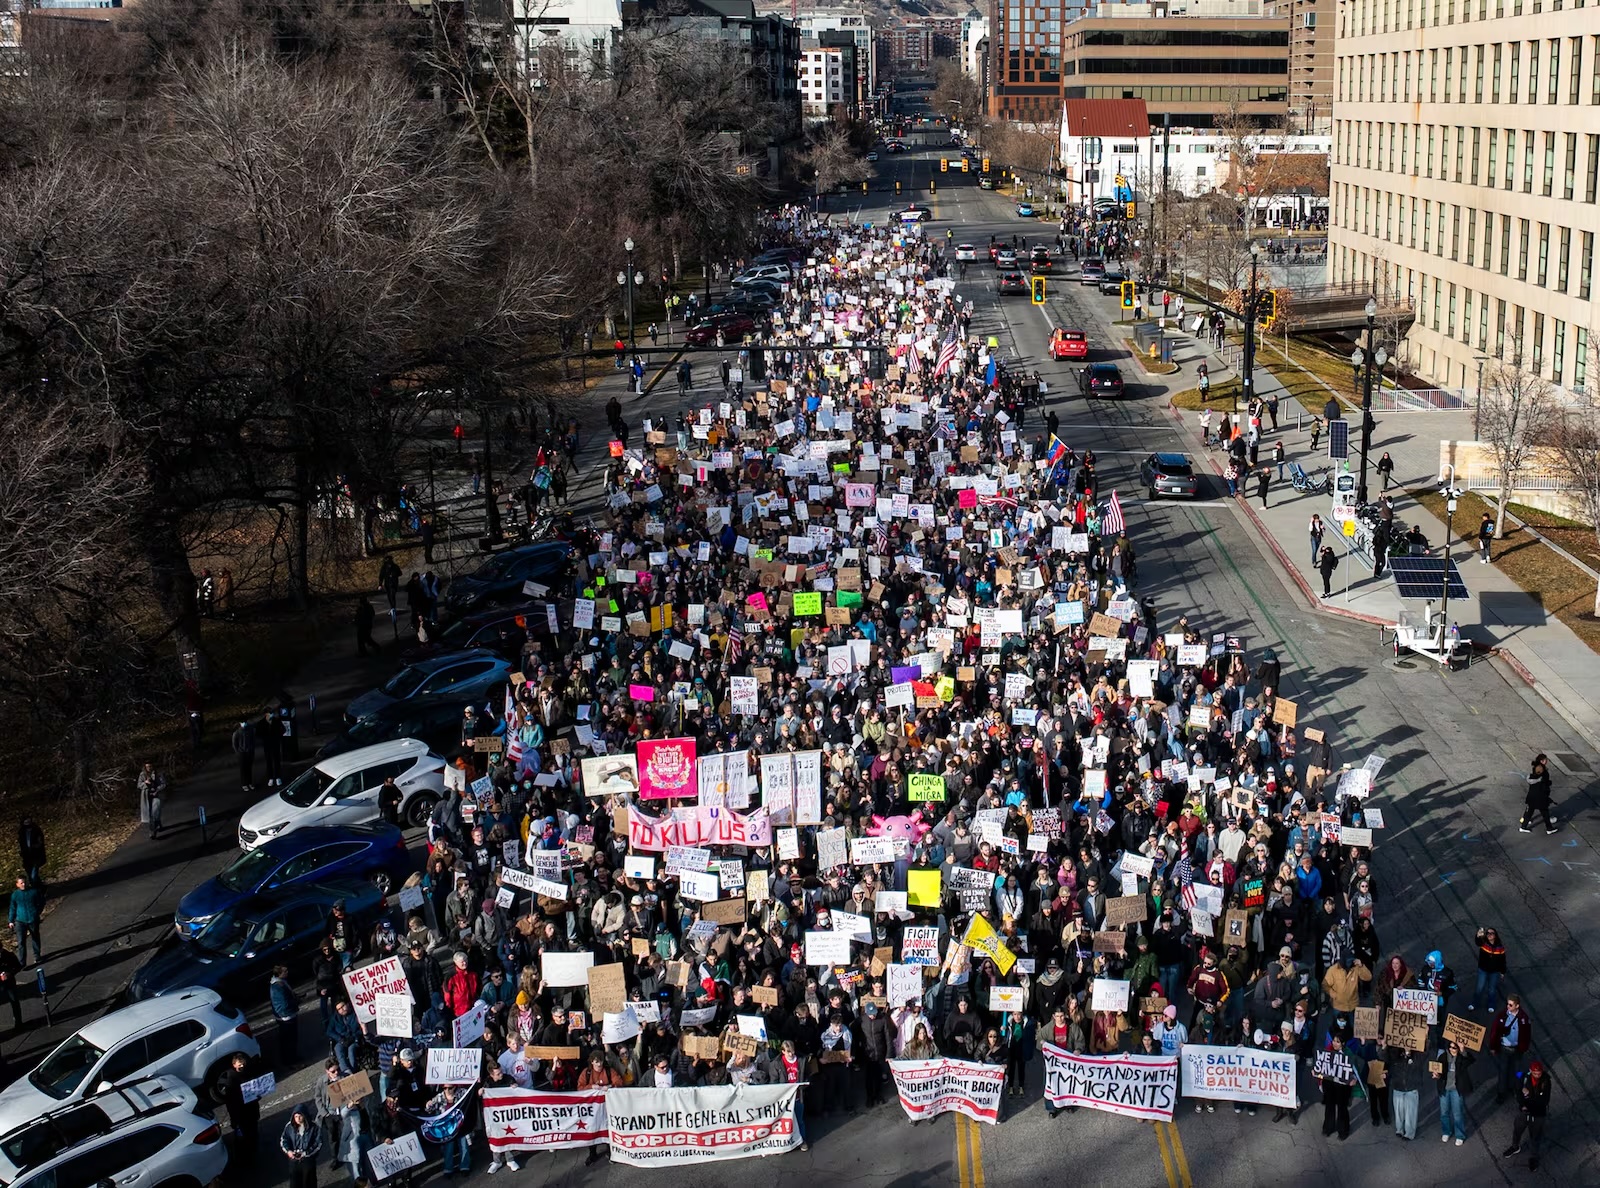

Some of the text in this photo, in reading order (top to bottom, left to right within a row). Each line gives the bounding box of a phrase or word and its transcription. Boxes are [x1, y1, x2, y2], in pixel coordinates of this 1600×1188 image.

[1007, 676, 1025, 684] ICE
[887, 684, 910, 695] PROTECT
[912, 776, 942, 786] CHINGA
[916, 791, 942, 800] MIGRA
[978, 810, 990, 818] ICE
[630, 819, 746, 848] TO KILL US
[1002, 838, 1018, 846] FUCK
[861, 848, 884, 856] PRIVILEGE
[536, 860, 558, 868] GENERAL
[1122, 863, 1150, 876] CRUSHED
[958, 869, 976, 878] KEEP
[502, 869, 562, 898] ARMED MIND
[682, 880, 696, 896] ICE
[1244, 880, 1262, 890] LOVE
[963, 888, 986, 897] CHINGA
[1248, 888, 1262, 898] NOT
[965, 902, 986, 910] MIGRA
[1108, 897, 1143, 910] ENOUGH
[1245, 896, 1264, 907] HATE
[1110, 906, 1146, 921] ALREADY
[1192, 913, 1210, 922] FUCK
[908, 928, 937, 939] FIGHT
[904, 940, 937, 949] IGNORANCE
[912, 948, 932, 957] NOT
[349, 960, 396, 988] WE WANT
[837, 970, 859, 980] SECRET
[891, 967, 906, 979] Ku
[892, 982, 918, 992] Klux
[1105, 992, 1118, 1000] NOT
[1396, 991, 1434, 1002] WE LOVE
[1394, 1001, 1436, 1012] AMERICA
[1356, 1010, 1360, 1020] I
[1387, 1008, 1427, 1029] PEOPLE
[1392, 1024, 1415, 1038] FOR
[726, 1034, 740, 1050] ICE
[1386, 1034, 1417, 1049] PEACE
[434, 1050, 477, 1064] NO HUMAN
[1207, 1054, 1290, 1072] SALT LAKE
[1316, 1050, 1351, 1068] WE ALL
[431, 1064, 475, 1079] IS ILLEGAL
[912, 1070, 930, 1078] FUTURE
[1044, 1055, 1176, 1082] MECHA STANDS WITH
[1314, 1061, 1352, 1081] SAW IT
[1206, 1066, 1290, 1084] COMMUNITY
[897, 1076, 1000, 1094] STUDENTS FIGHT BACK
[1048, 1071, 1174, 1108] IMMIGRANTS
[1206, 1076, 1290, 1095] BAIL FUND
[493, 1106, 595, 1123] STUDENTS SAY ICE
[609, 1099, 792, 1132] EXPAND THE GENERAL STRIKE
[532, 1119, 553, 1132] OUT
[523, 1136, 544, 1144] MECHA
[544, 1135, 552, 1143] DE
[553, 1134, 558, 1142] U
[558, 1134, 566, 1142] OF
[612, 1120, 794, 1148] STOP ICE TERROR!
[406, 1138, 418, 1152] LA
[640, 1150, 672, 1160] SOCIALISM
[680, 1150, 716, 1158] LIBERATION
[382, 1156, 414, 1176] CHINGA
